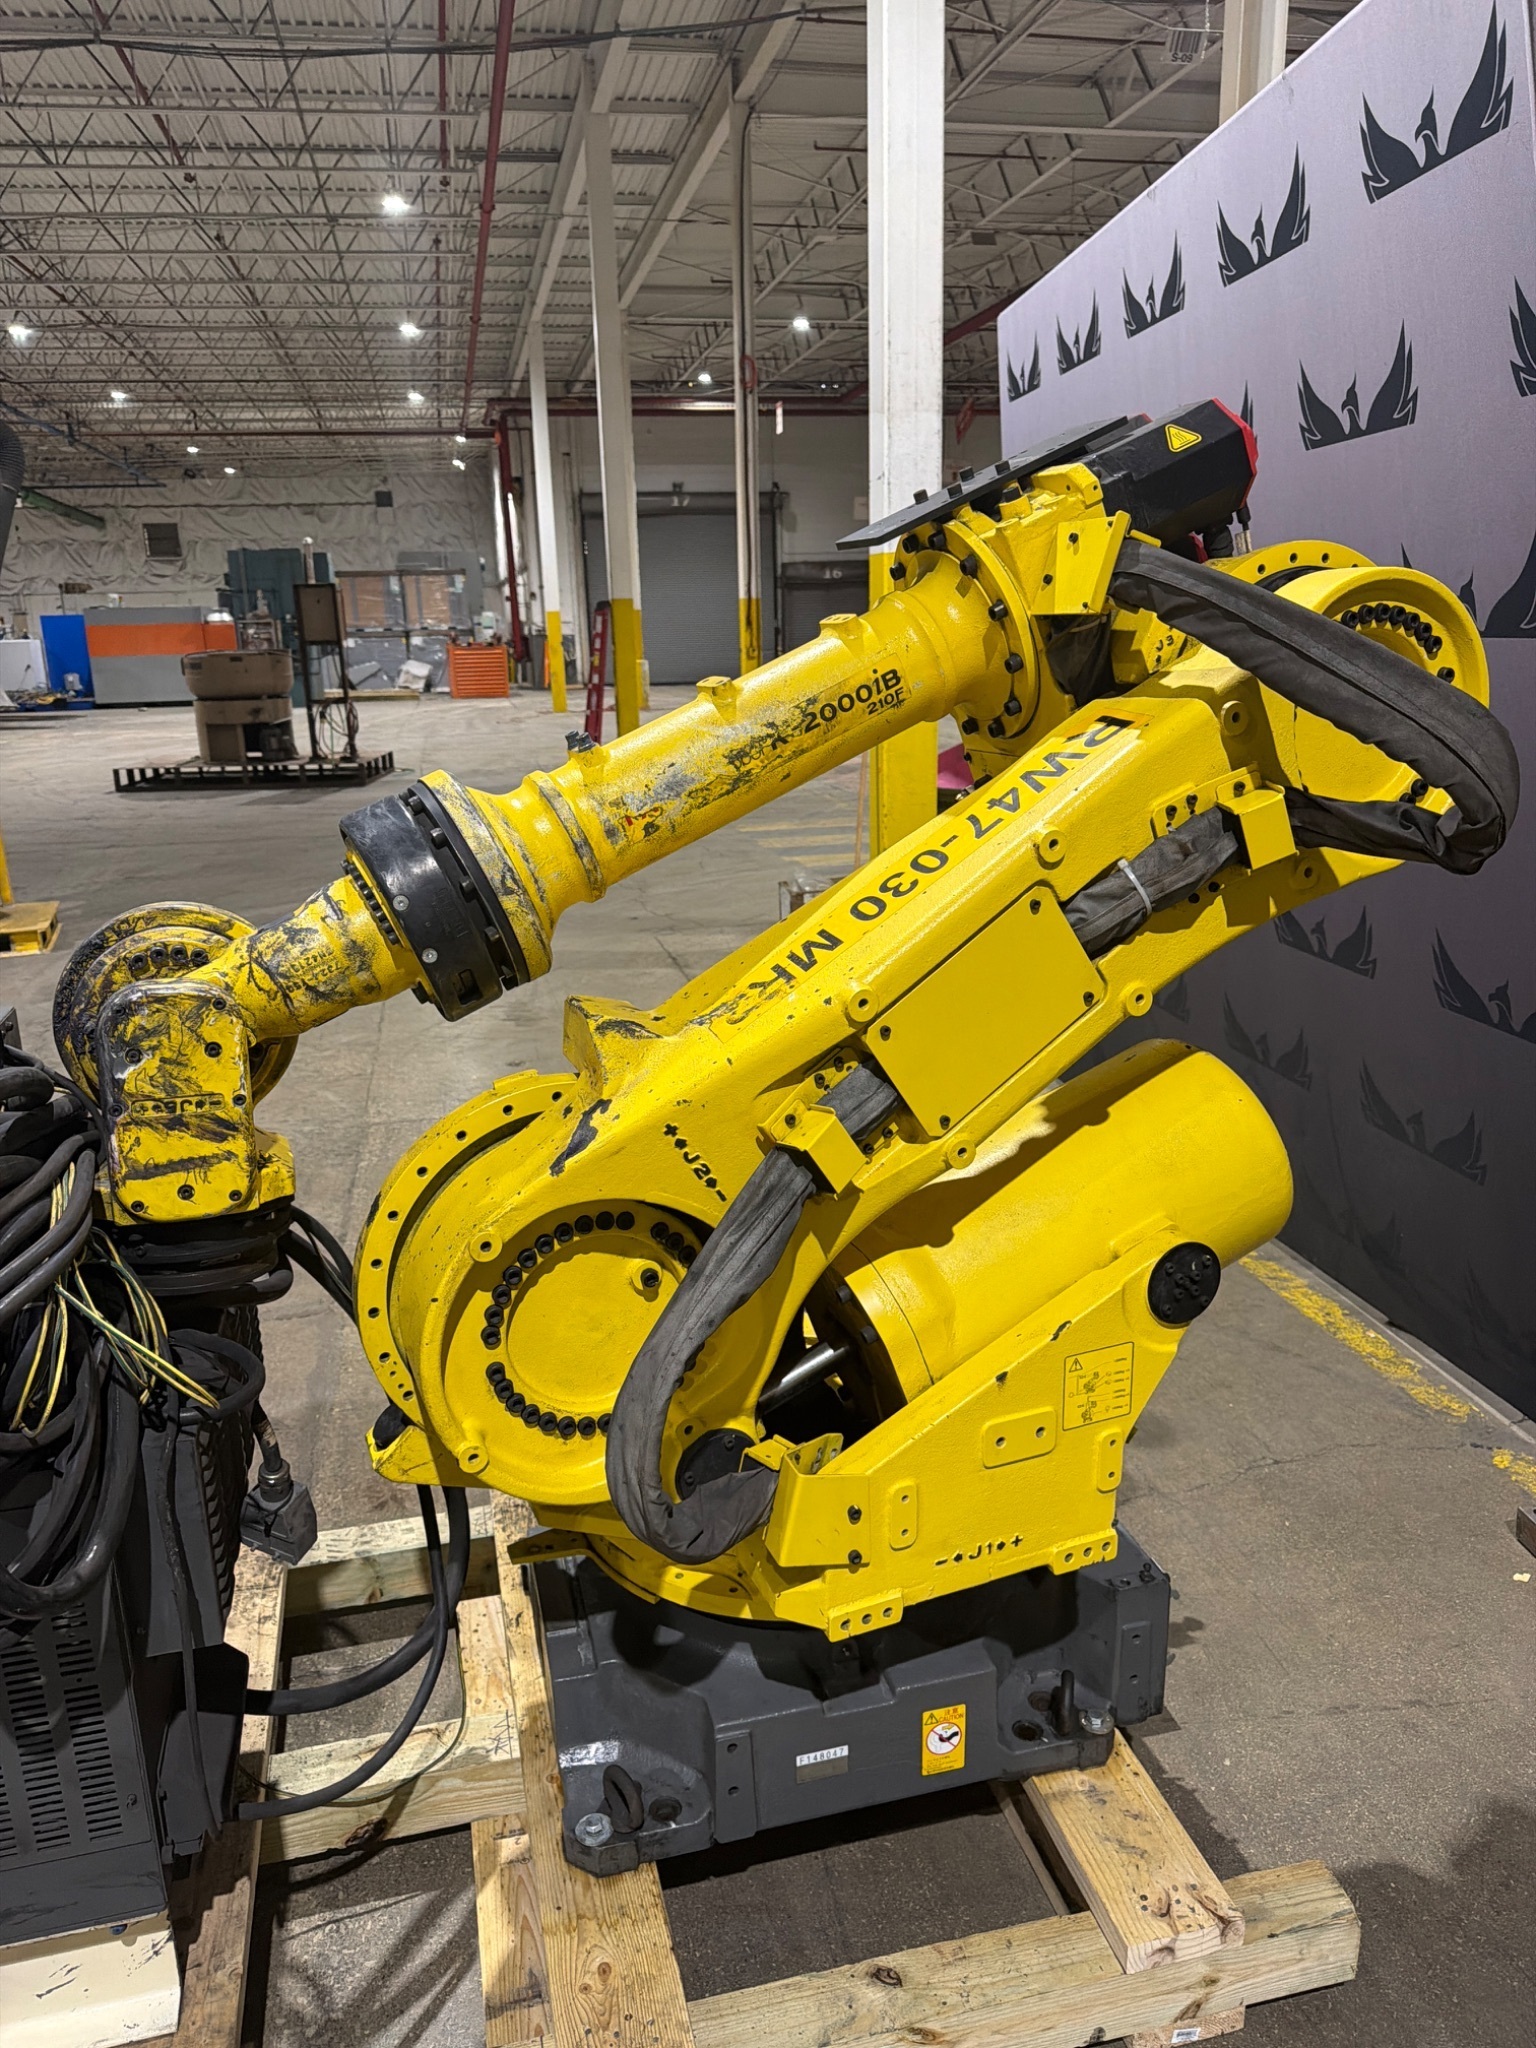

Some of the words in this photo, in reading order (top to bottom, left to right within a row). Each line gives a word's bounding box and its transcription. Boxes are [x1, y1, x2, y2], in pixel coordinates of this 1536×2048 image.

[867, 686, 904, 715] 210F
[938, 1713, 965, 1722] CAUTION
[799, 1747, 845, 1765] F148047
